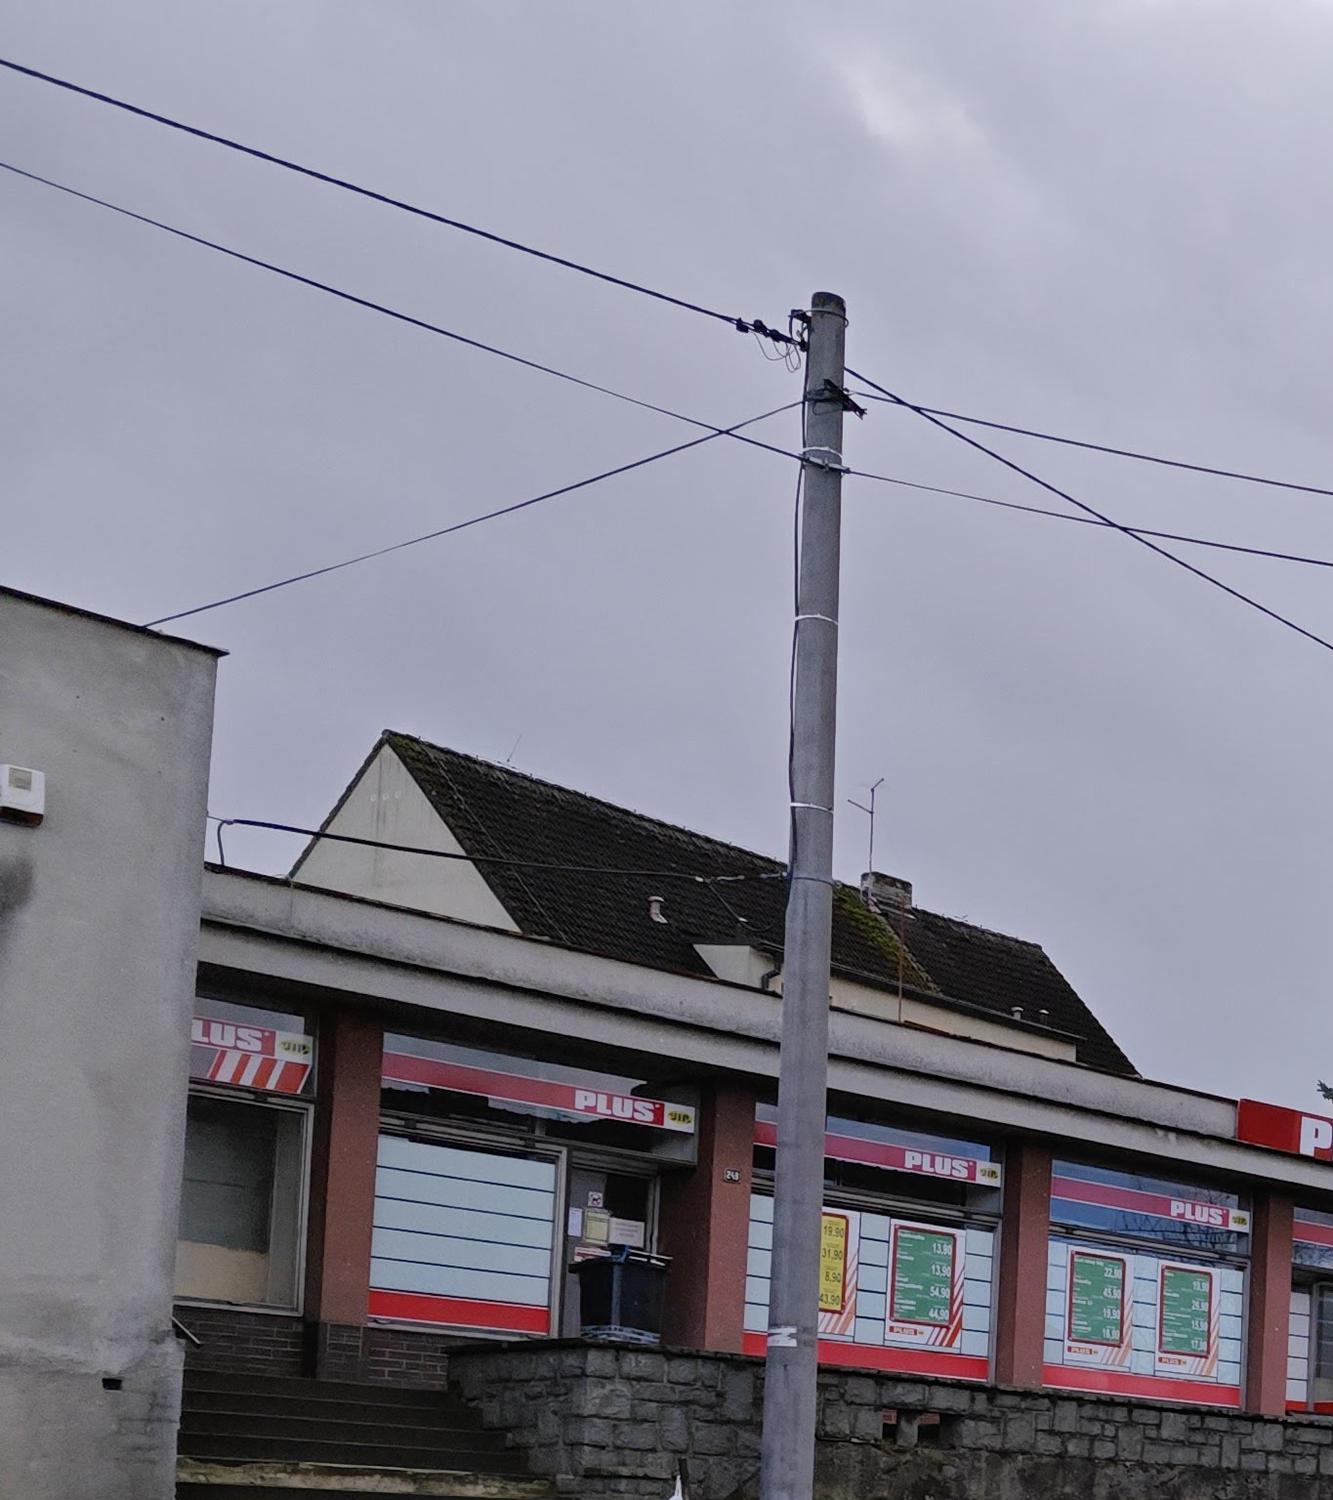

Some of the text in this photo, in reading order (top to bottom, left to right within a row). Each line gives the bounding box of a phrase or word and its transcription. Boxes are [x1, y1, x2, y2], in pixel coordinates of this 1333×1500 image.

[192, 1018, 263, 1053] LUS
[573, 1089, 655, 1122] PLUS
[903, 1150, 970, 1178] PLUS
[1169, 1200, 1224, 1226] PLUS
